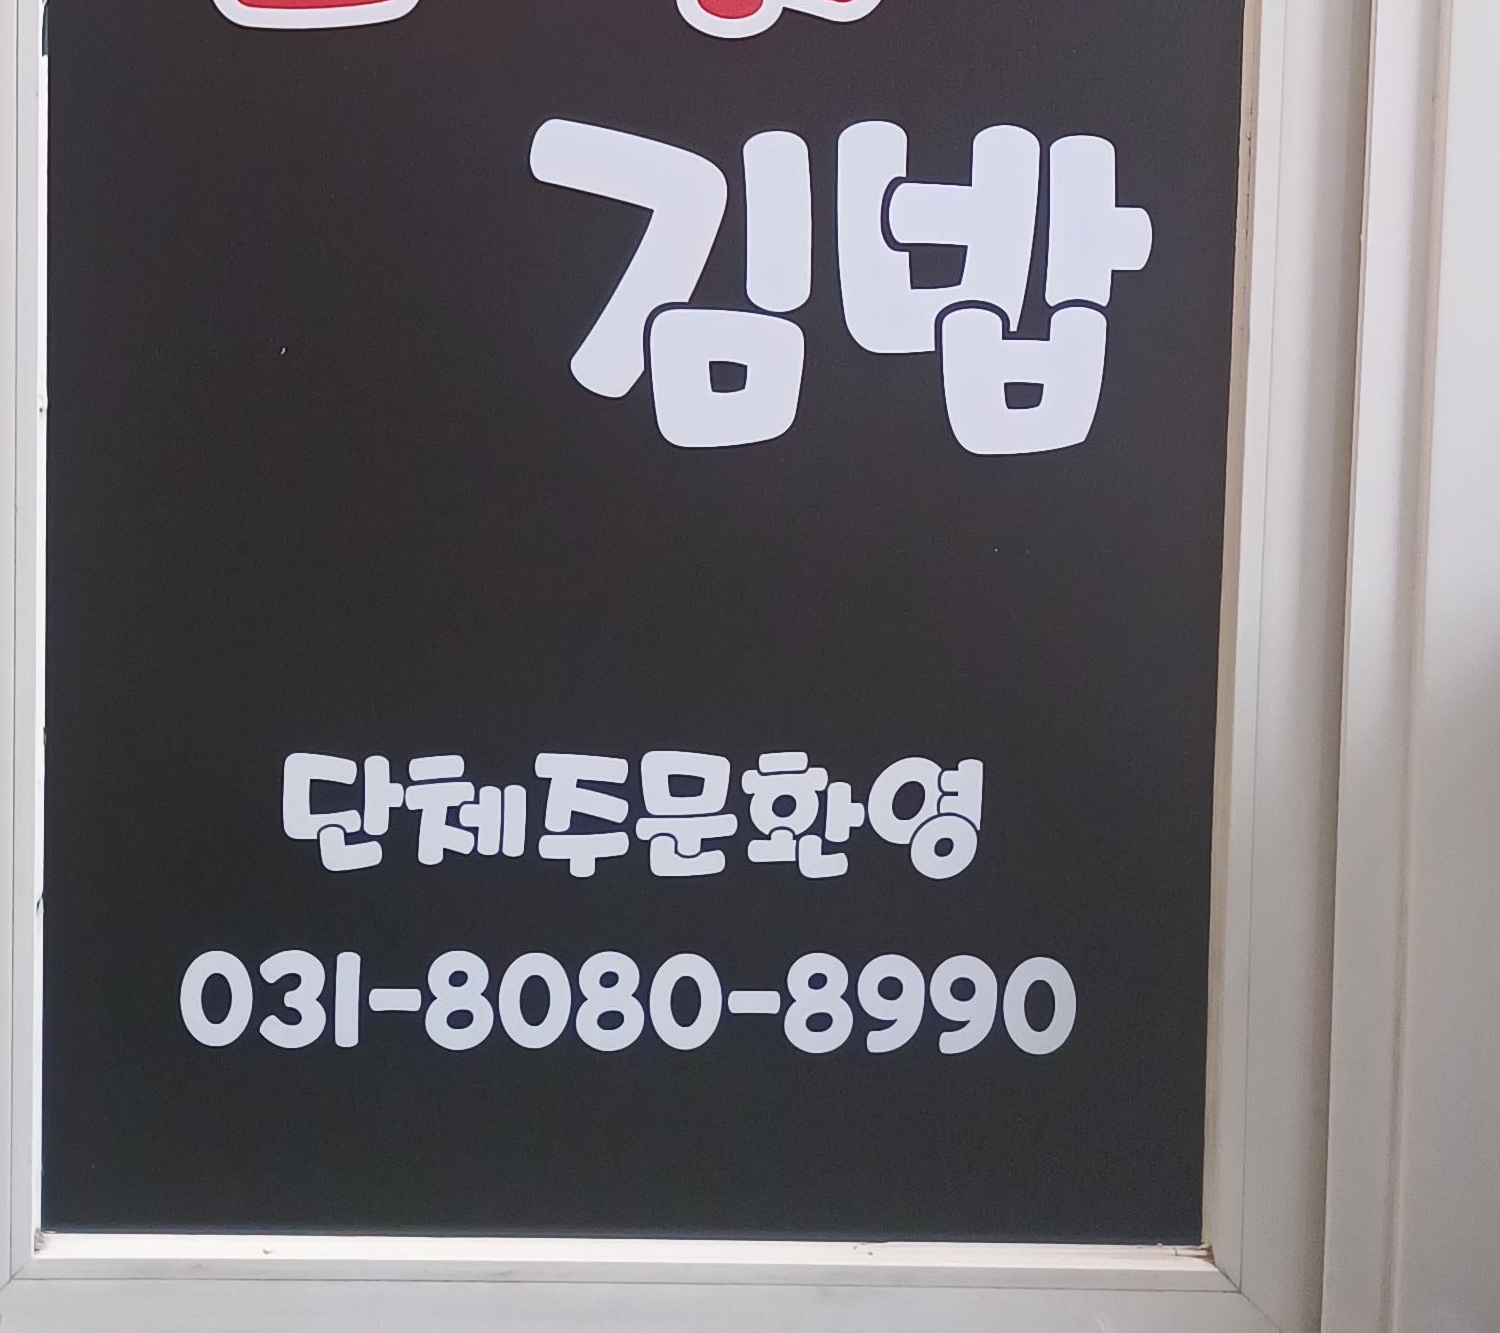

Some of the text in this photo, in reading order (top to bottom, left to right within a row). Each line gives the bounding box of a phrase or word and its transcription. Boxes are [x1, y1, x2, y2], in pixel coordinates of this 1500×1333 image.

[530, 118, 1153, 455] 김밥
[283, 750, 984, 880] 단체주문환영
[180, 950, 1077, 1055] 031-8080-8990
